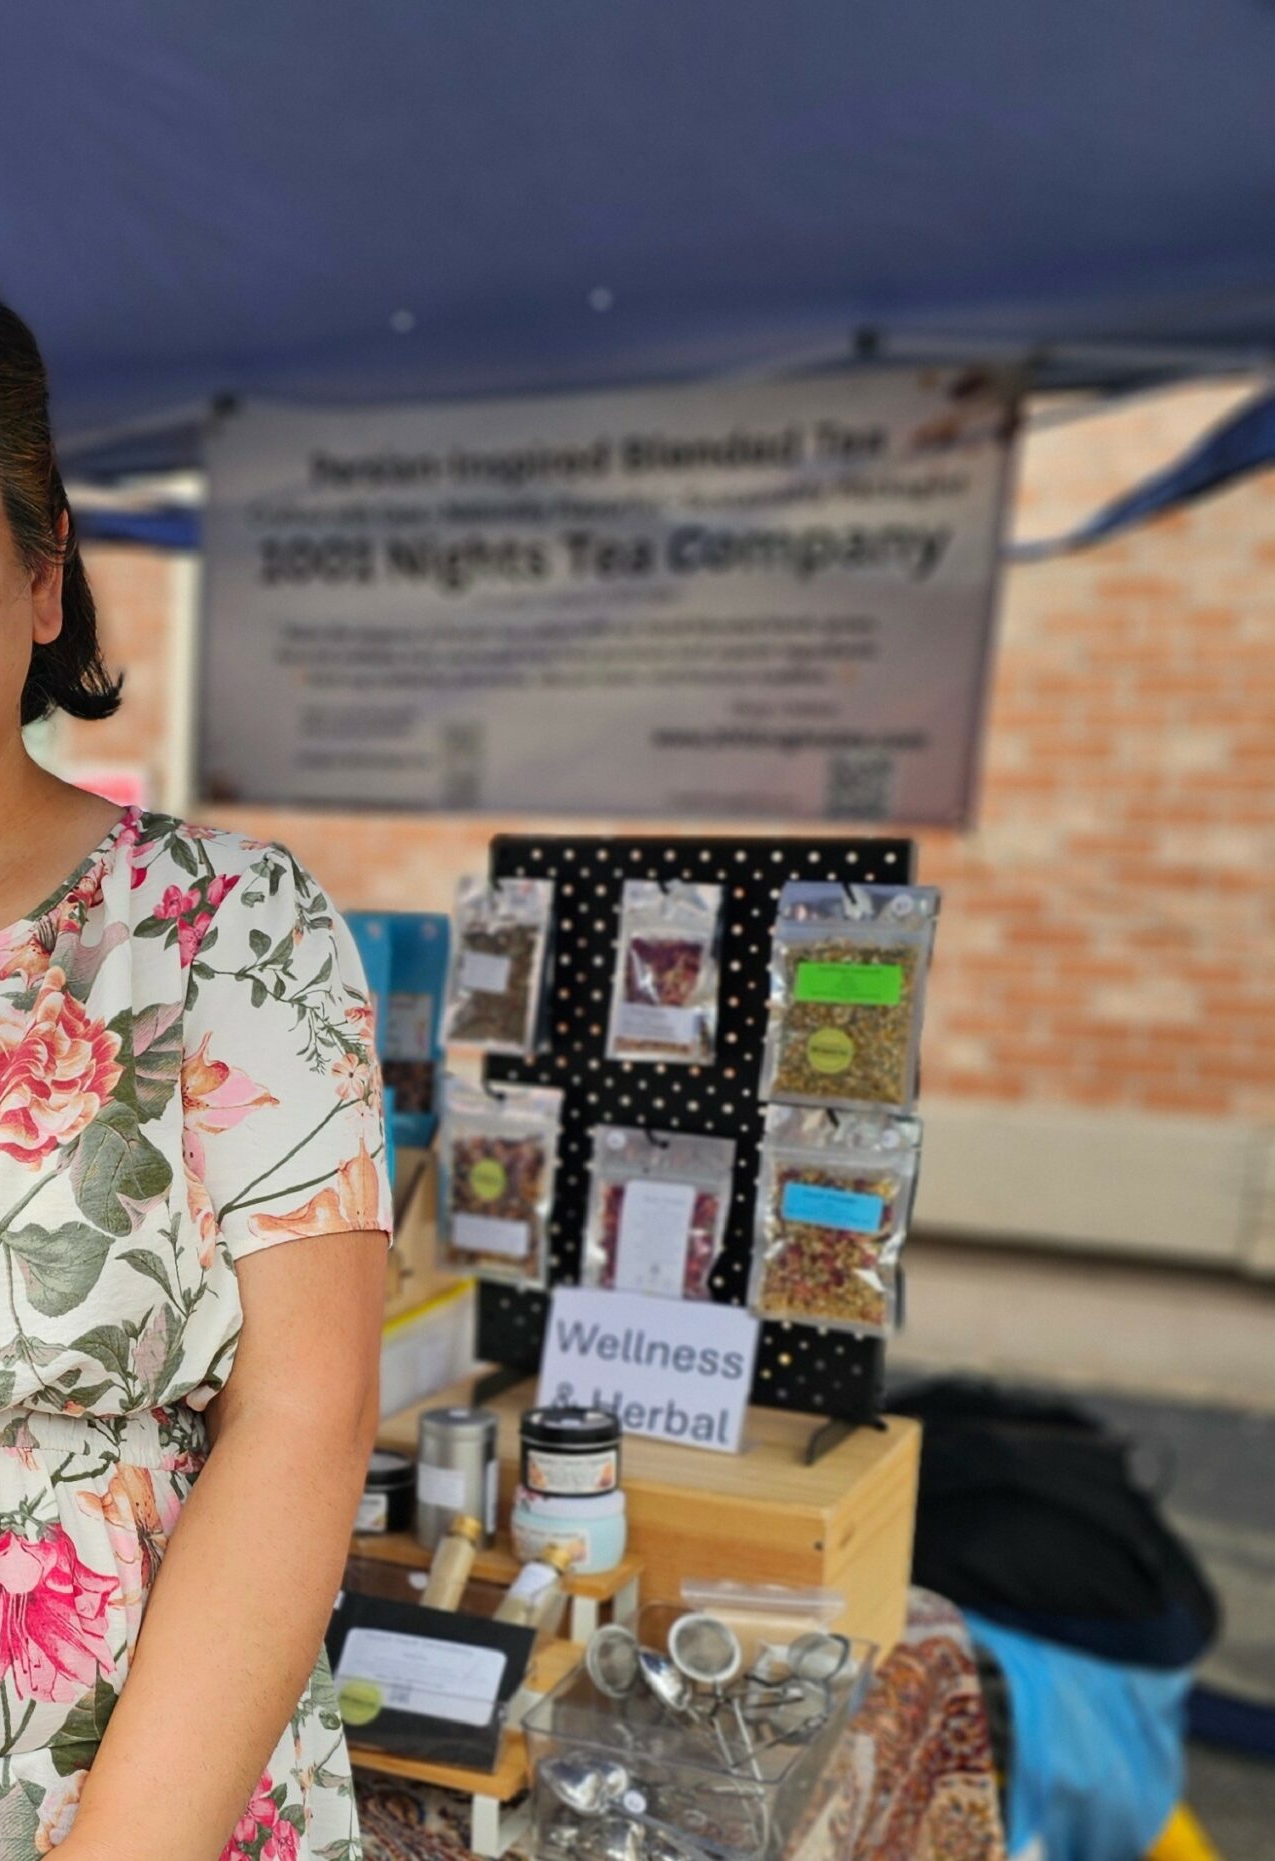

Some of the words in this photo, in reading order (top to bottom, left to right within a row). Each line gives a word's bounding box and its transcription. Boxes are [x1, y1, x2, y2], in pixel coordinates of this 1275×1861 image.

[385, 532, 553, 594] Nights
[565, 528, 654, 581] Tea
[667, 522, 956, 582] Company
[556, 1318, 745, 1381] Wellness
[591, 1388, 730, 1445] Herbal
